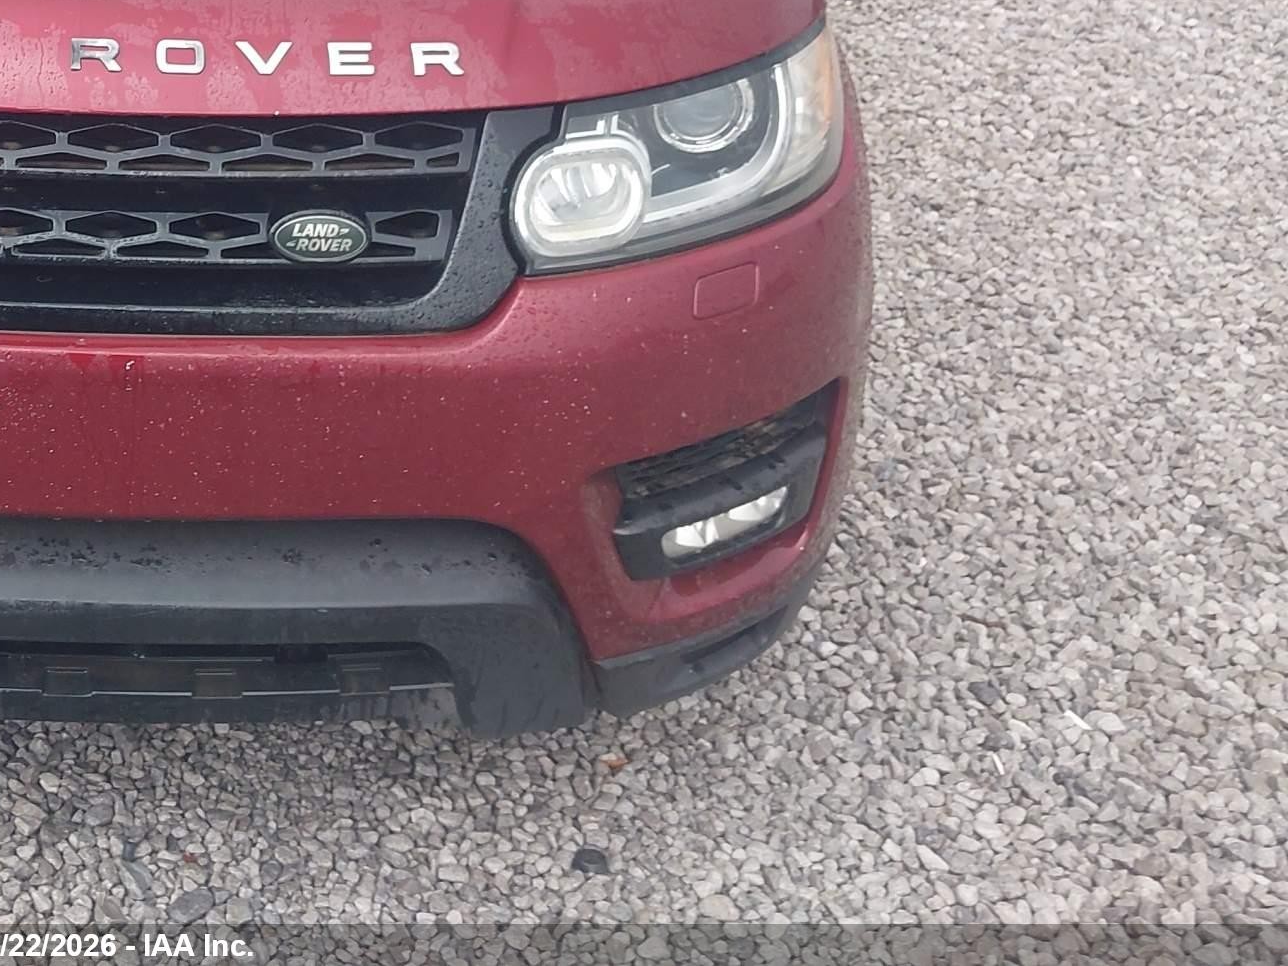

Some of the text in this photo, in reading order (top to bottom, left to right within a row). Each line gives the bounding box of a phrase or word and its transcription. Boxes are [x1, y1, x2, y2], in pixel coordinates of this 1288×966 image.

[70, 37, 465, 76] ROVER
[292, 223, 339, 237] LAND
[295, 238, 353, 252] ROVER
